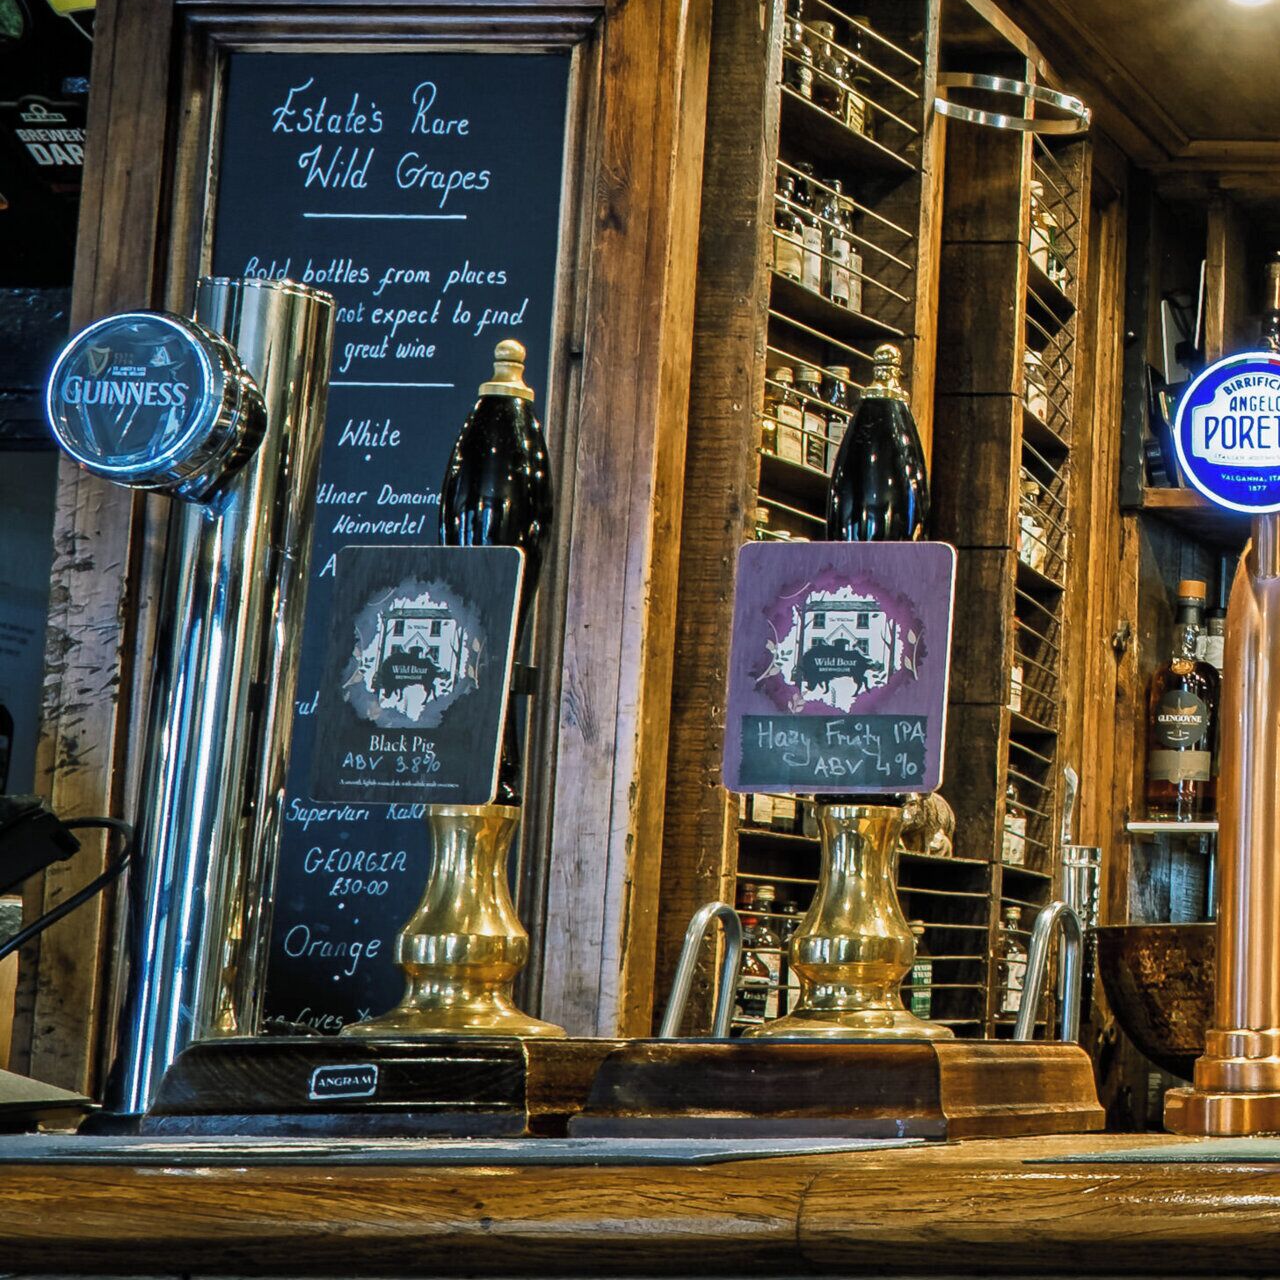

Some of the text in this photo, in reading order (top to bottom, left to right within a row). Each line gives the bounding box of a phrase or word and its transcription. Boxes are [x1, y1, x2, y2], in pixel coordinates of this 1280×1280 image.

[272, 77, 469, 135] Estate's Rare
[299, 145, 491, 208] Wild Grapes
[303, 258, 369, 283] bottles
[373, 268, 429, 296] from
[443, 260, 507, 293] places
[372, 300, 441, 338] expect
[452, 300, 471, 324] to
[474, 298, 529, 337] find
[340, 336, 436, 373] great wine
[61, 375, 189, 406] GUINNESS
[338, 419, 400, 447] White
[815, 657, 857, 667] Wild Boar
[369, 735, 435, 756] Black Pig
[758, 720, 925, 766] Hazy Fruity IPA
[343, 753, 382, 769] ABV
[814, 757, 864, 776] ABV
[304, 847, 407, 874] GEORGIA
[284, 925, 382, 976] Orange
[317, 1076, 372, 1088] ANGRAM
